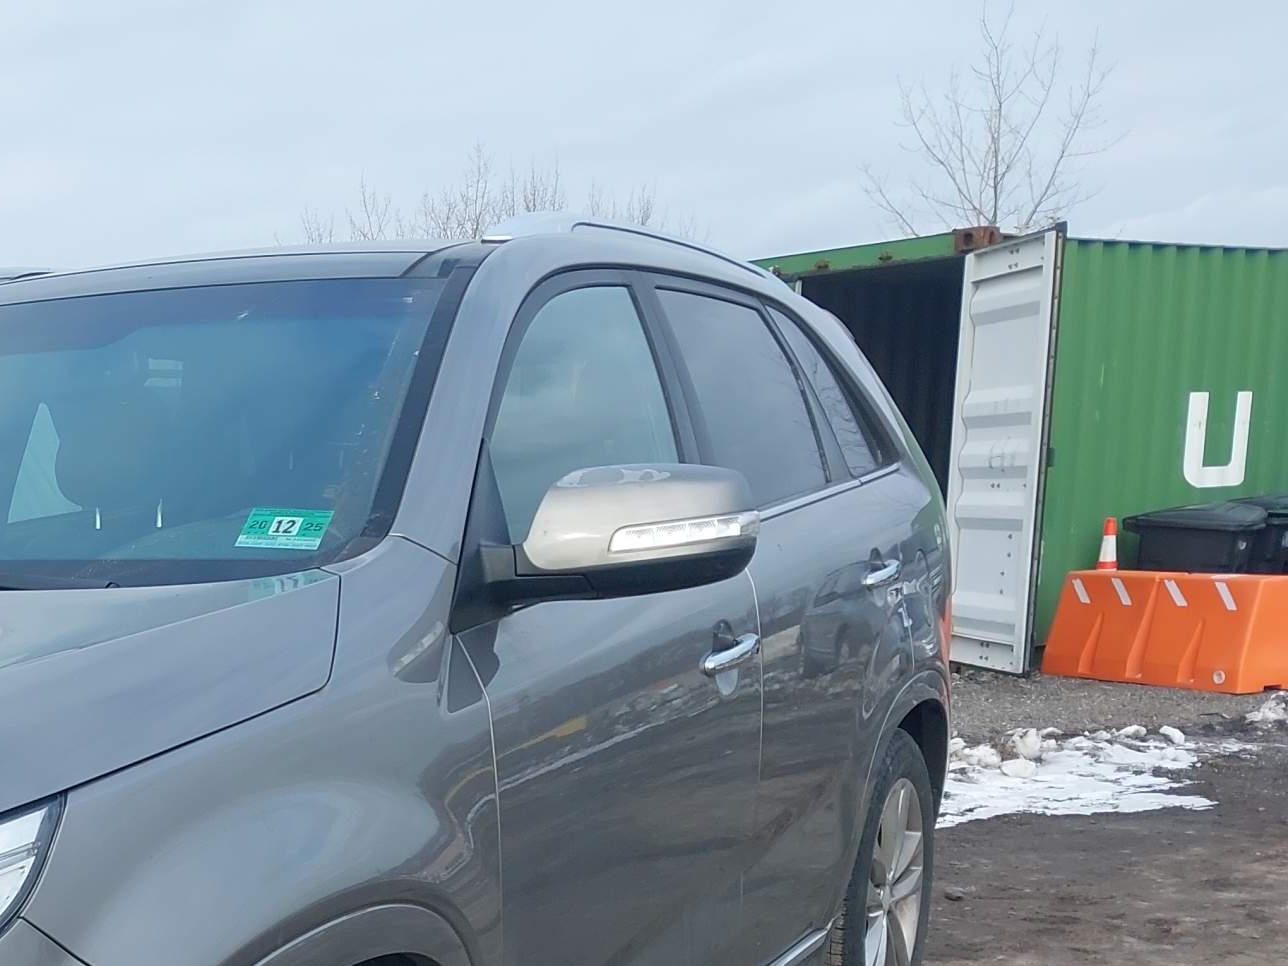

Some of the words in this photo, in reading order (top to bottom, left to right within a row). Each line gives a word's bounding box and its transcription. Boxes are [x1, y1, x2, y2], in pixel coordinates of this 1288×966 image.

[1183, 391, 1254, 488] U
[249, 520, 267, 530] 20
[272, 519, 297, 534] 12
[303, 522, 324, 532] 25
